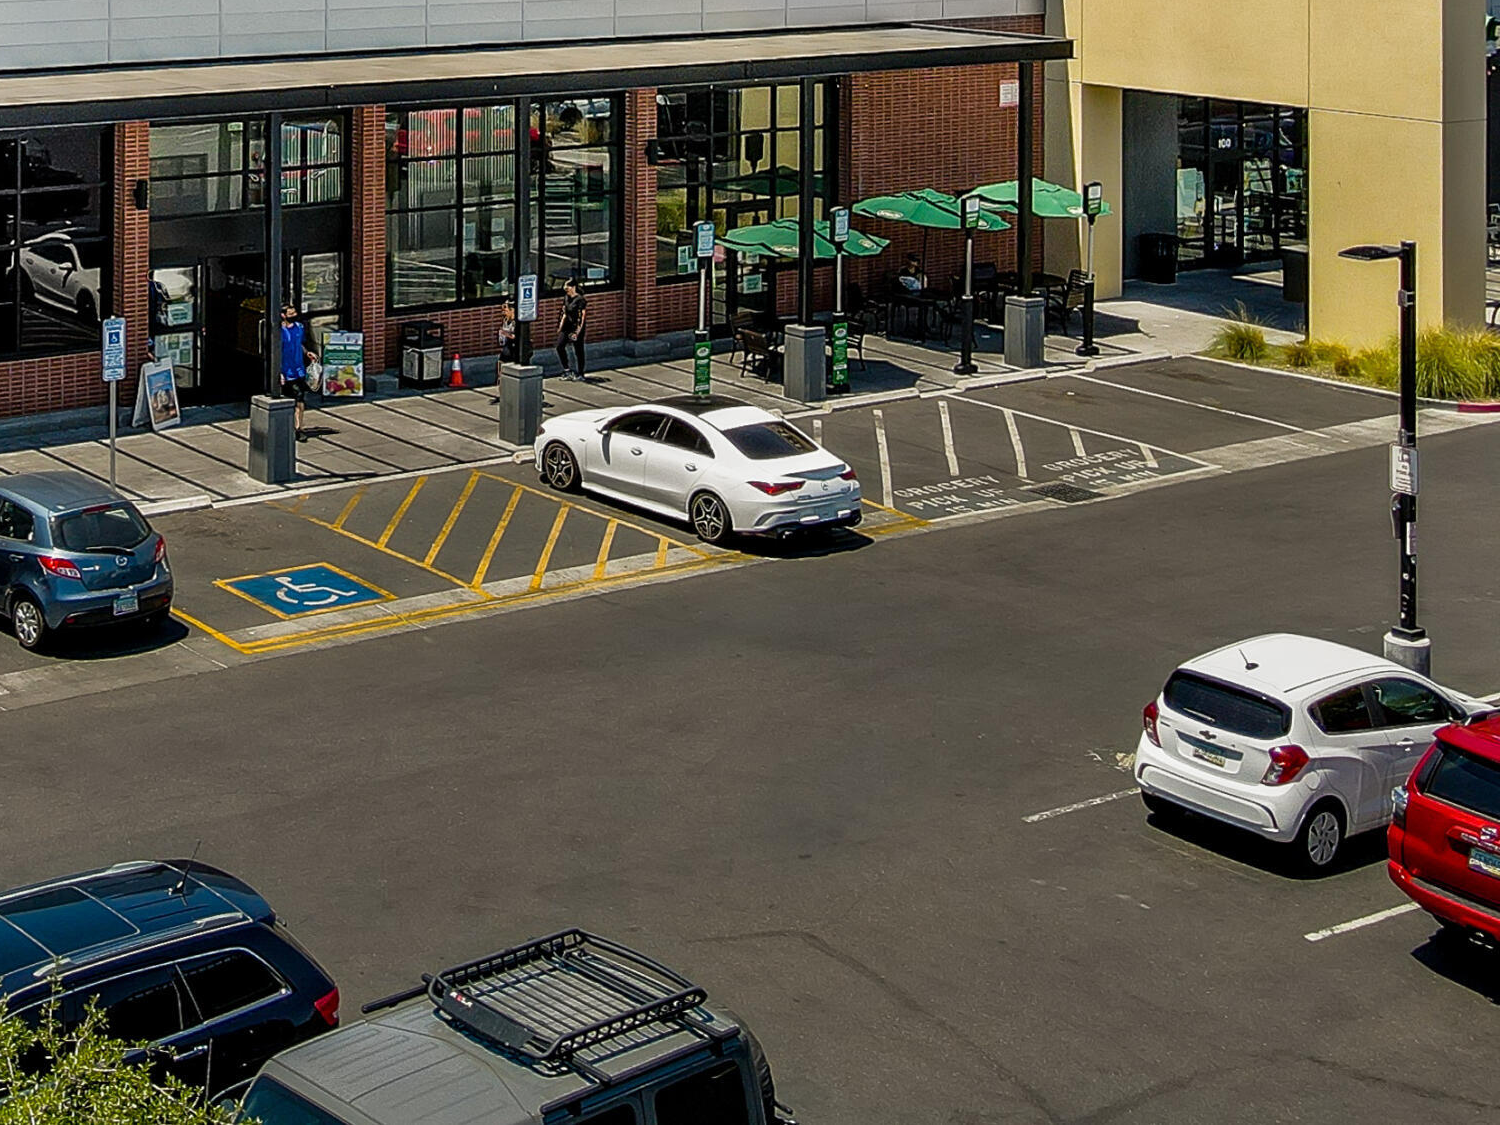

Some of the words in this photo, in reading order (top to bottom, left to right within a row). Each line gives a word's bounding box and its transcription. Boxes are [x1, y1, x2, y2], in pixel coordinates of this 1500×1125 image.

[1042, 448, 1140, 471] GROCERY
[1058, 466, 1117, 483] PICK
[893, 475, 1000, 498] GROCERY
[905, 494, 969, 510] PICK
